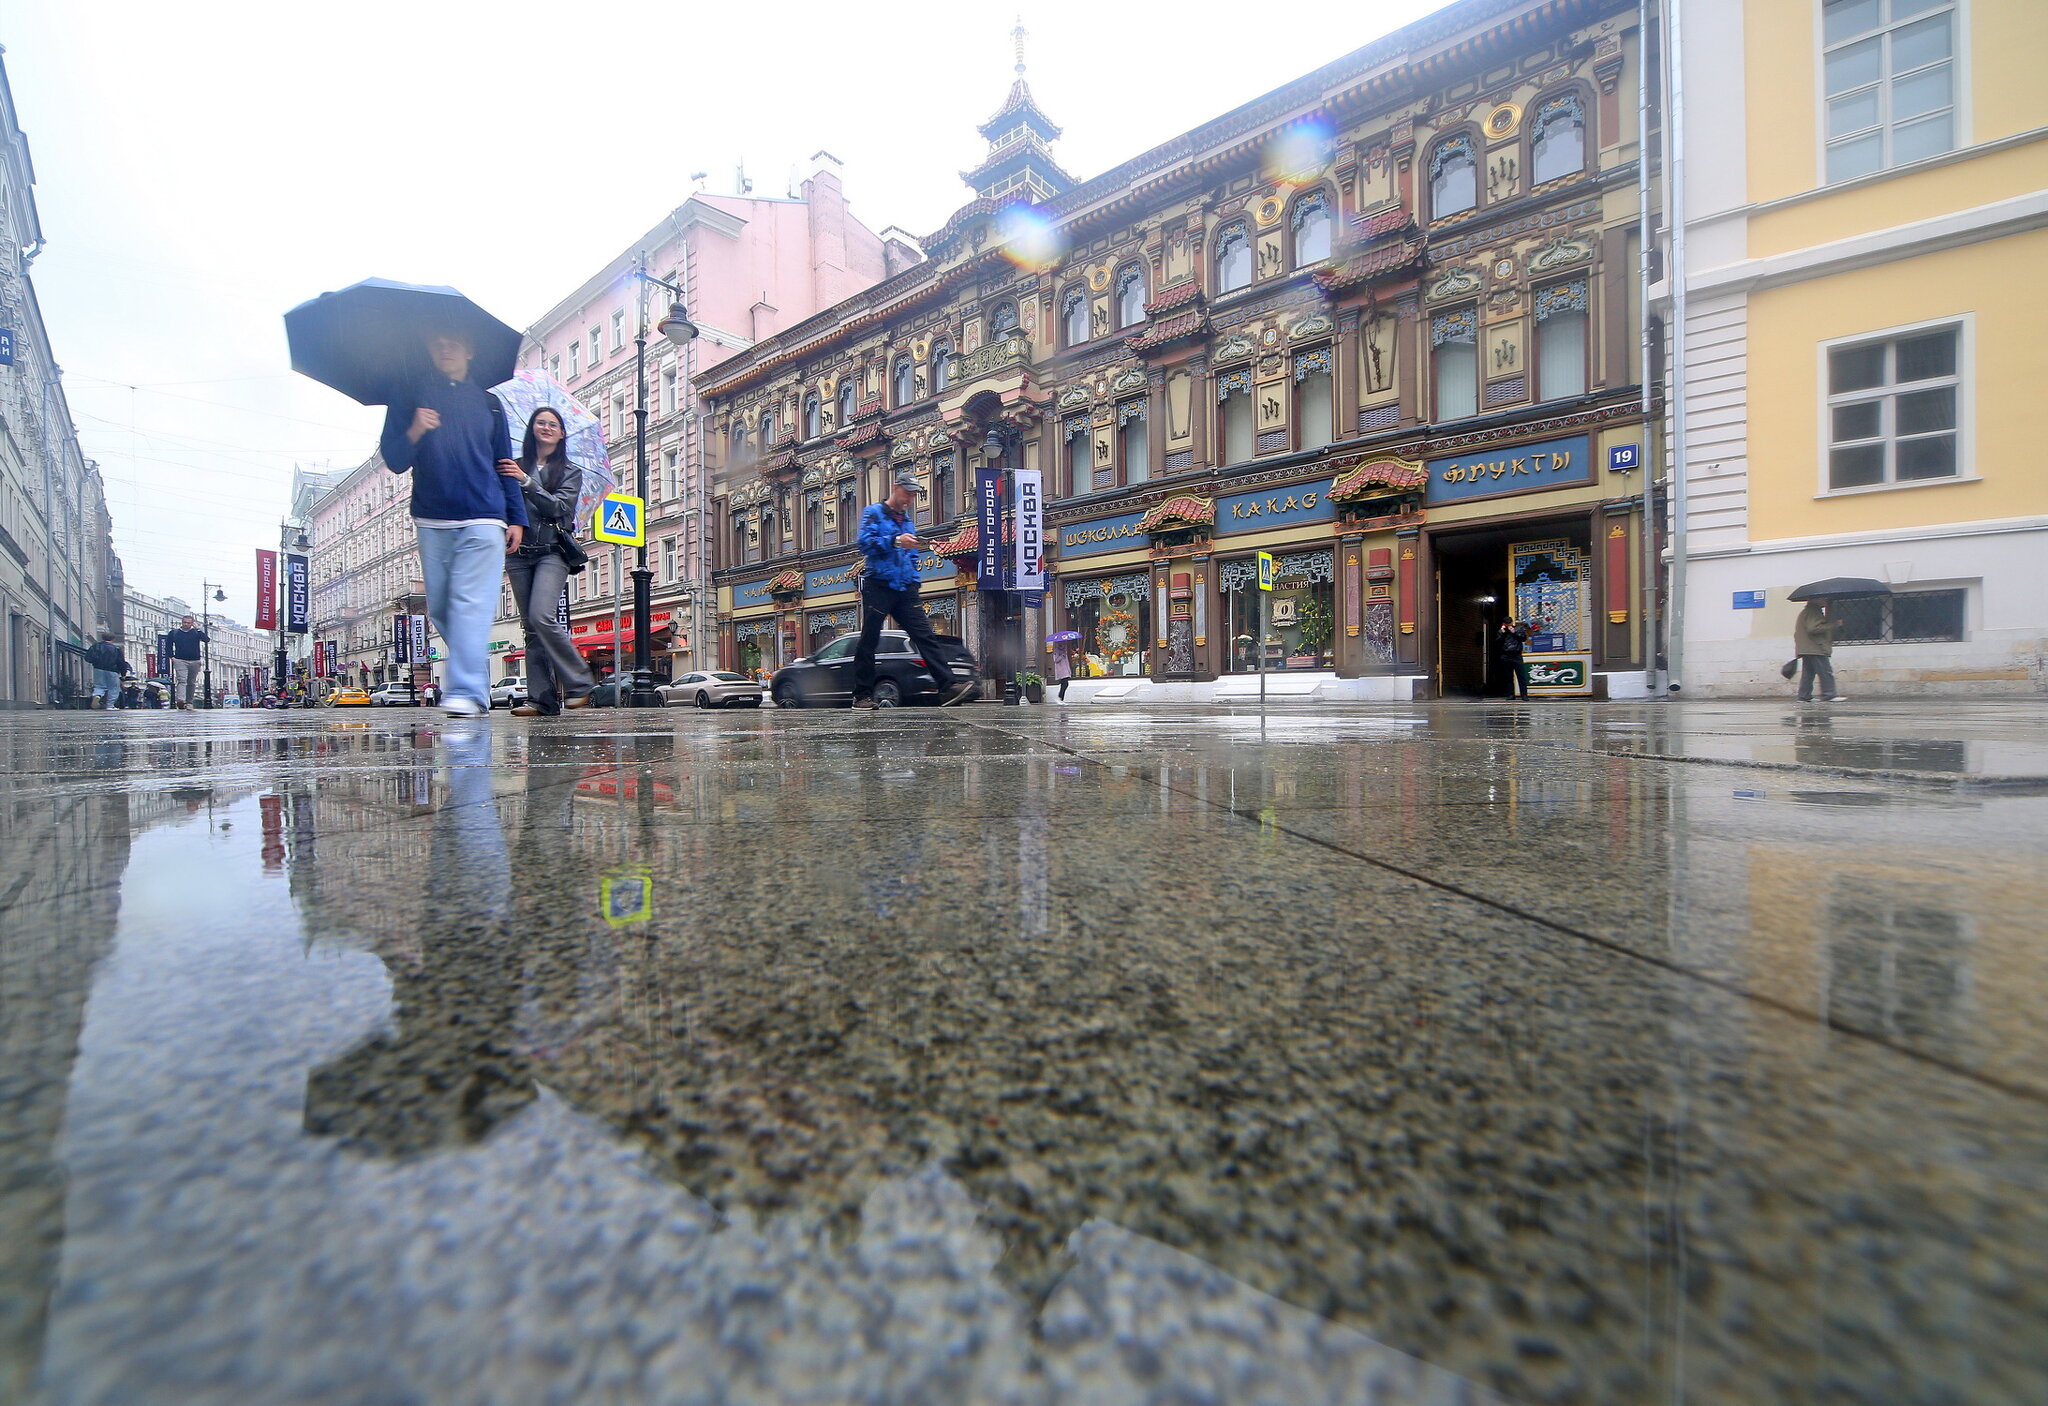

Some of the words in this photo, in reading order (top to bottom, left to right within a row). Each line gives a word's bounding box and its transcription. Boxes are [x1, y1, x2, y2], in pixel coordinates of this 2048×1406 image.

[1442, 451, 1571, 484] ФРУКТЫ
[1614, 450, 1632, 464] 19
[985, 480, 995, 535] ГОРОДА
[1231, 492, 1318, 520] КАКАО
[1022, 483, 1037, 576] МОСКВА
[986, 538, 995, 576] ДЕНЬ
[263, 557, 271, 594] ГОРОДА
[293, 562, 305, 624] МОСКВА
[1272, 580, 1310, 592] НАСТИЯ
[262, 596, 270, 621] ДЕНЬ
